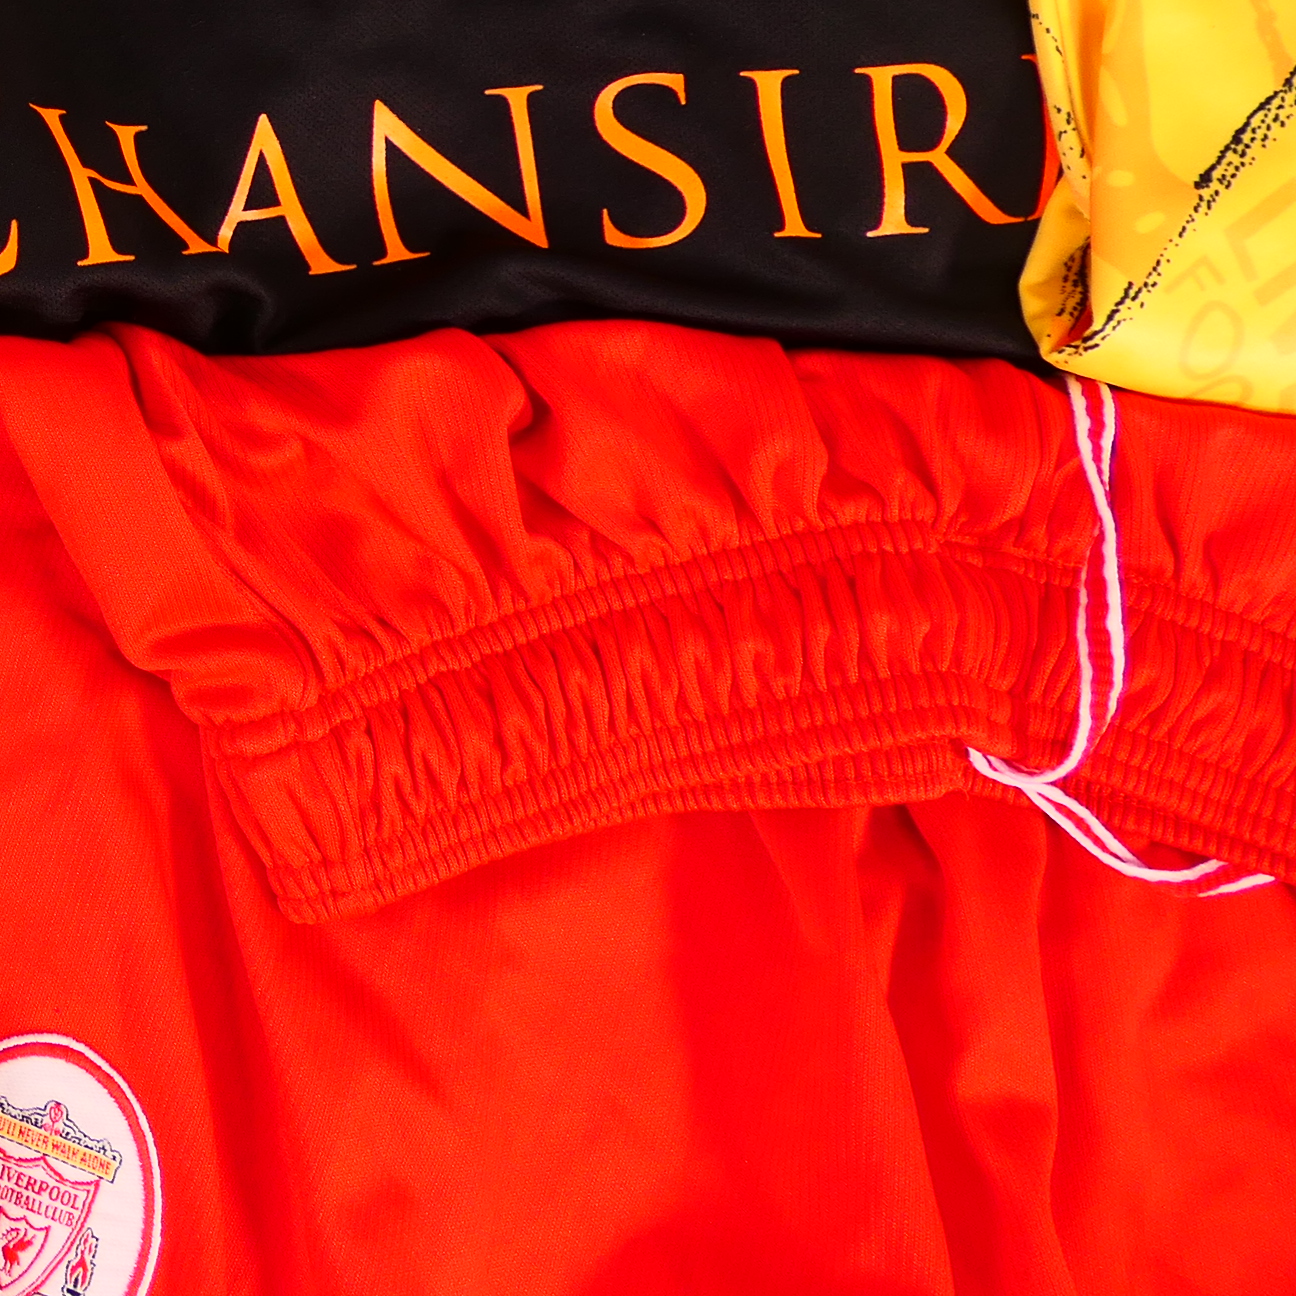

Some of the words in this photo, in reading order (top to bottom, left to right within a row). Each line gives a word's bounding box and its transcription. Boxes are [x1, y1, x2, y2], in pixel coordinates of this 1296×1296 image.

[18, 1125, 50, 1150] NEVER
[51, 1136, 79, 1160] WALK
[80, 1151, 112, 1175] ALONE
[44, 1205, 75, 1227] CLUB
